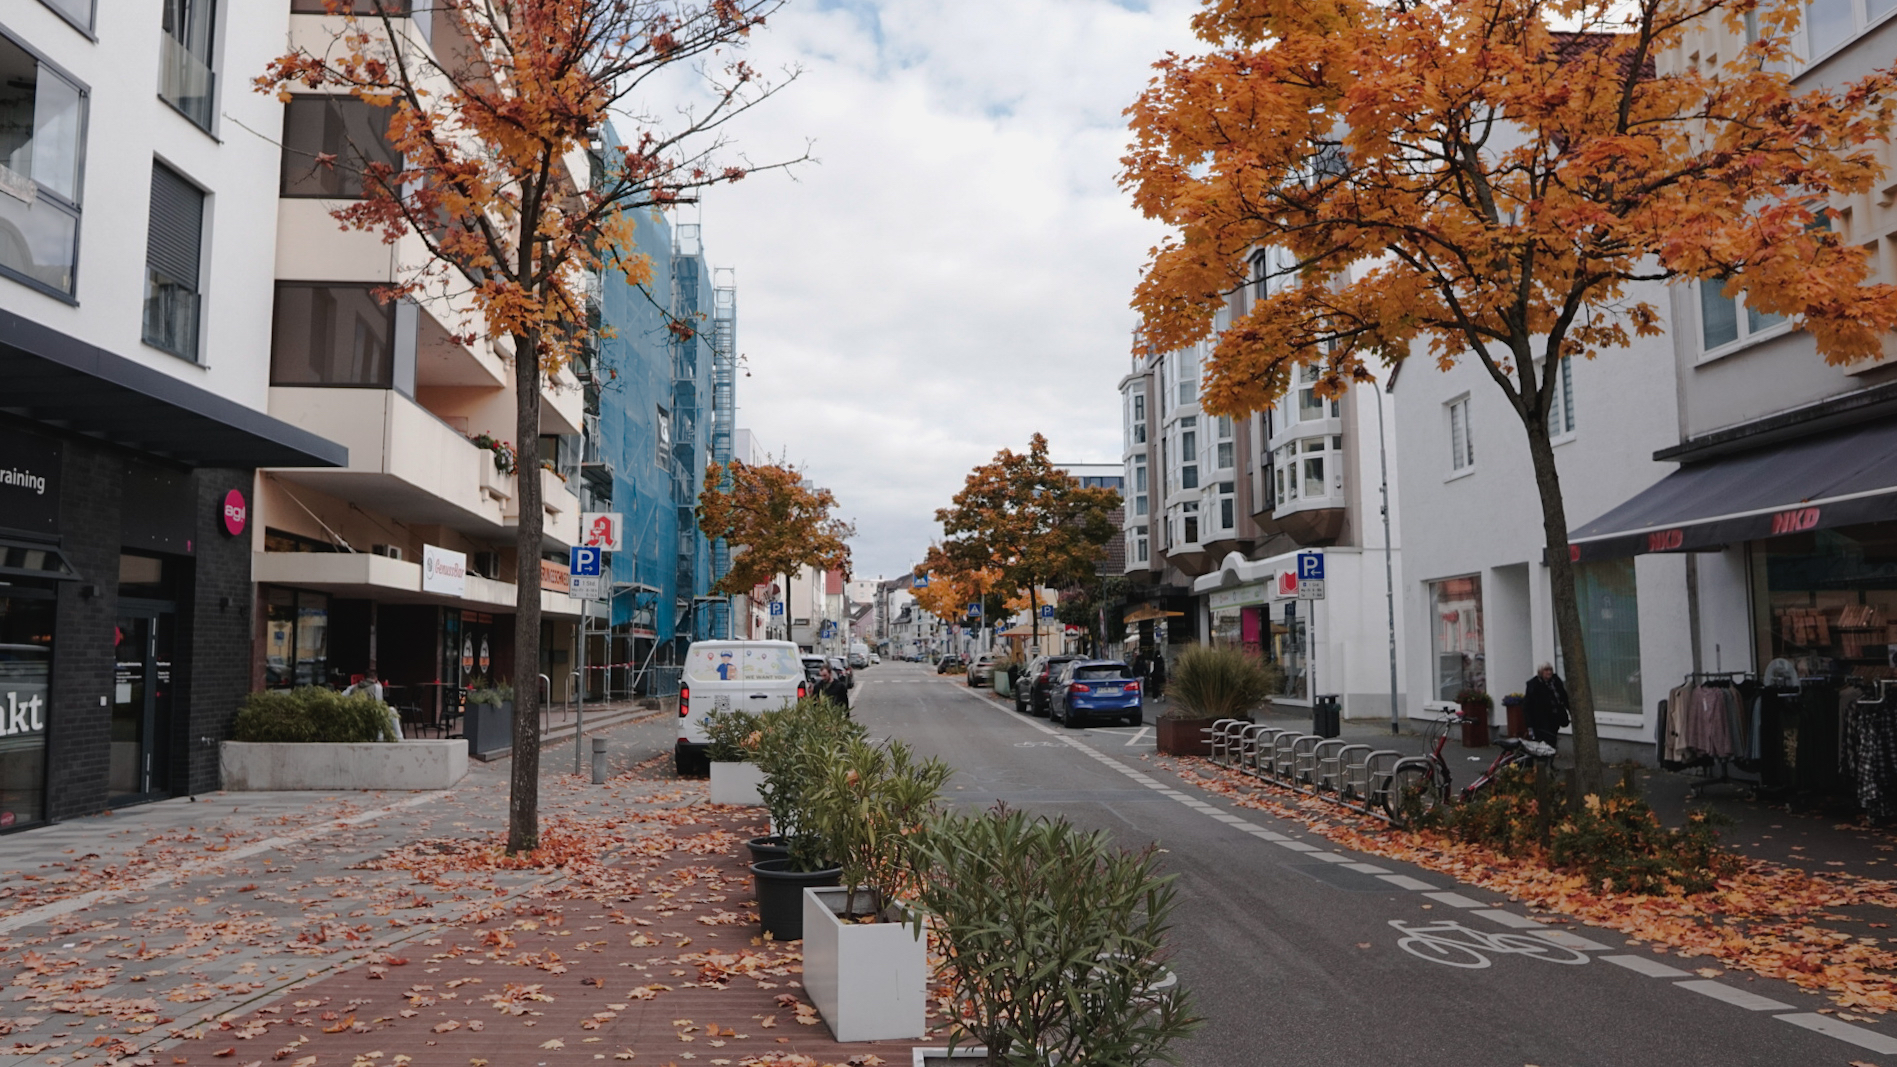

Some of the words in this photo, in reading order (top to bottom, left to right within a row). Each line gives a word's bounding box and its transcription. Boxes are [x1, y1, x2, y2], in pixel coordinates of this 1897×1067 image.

[1772, 508, 1820, 534] NKD
[1649, 529, 1683, 551] NKD
[577, 550, 594, 572] P
[1304, 557, 1318, 576] P
[773, 604, 780, 613] P
[1044, 607, 1051, 616] P
